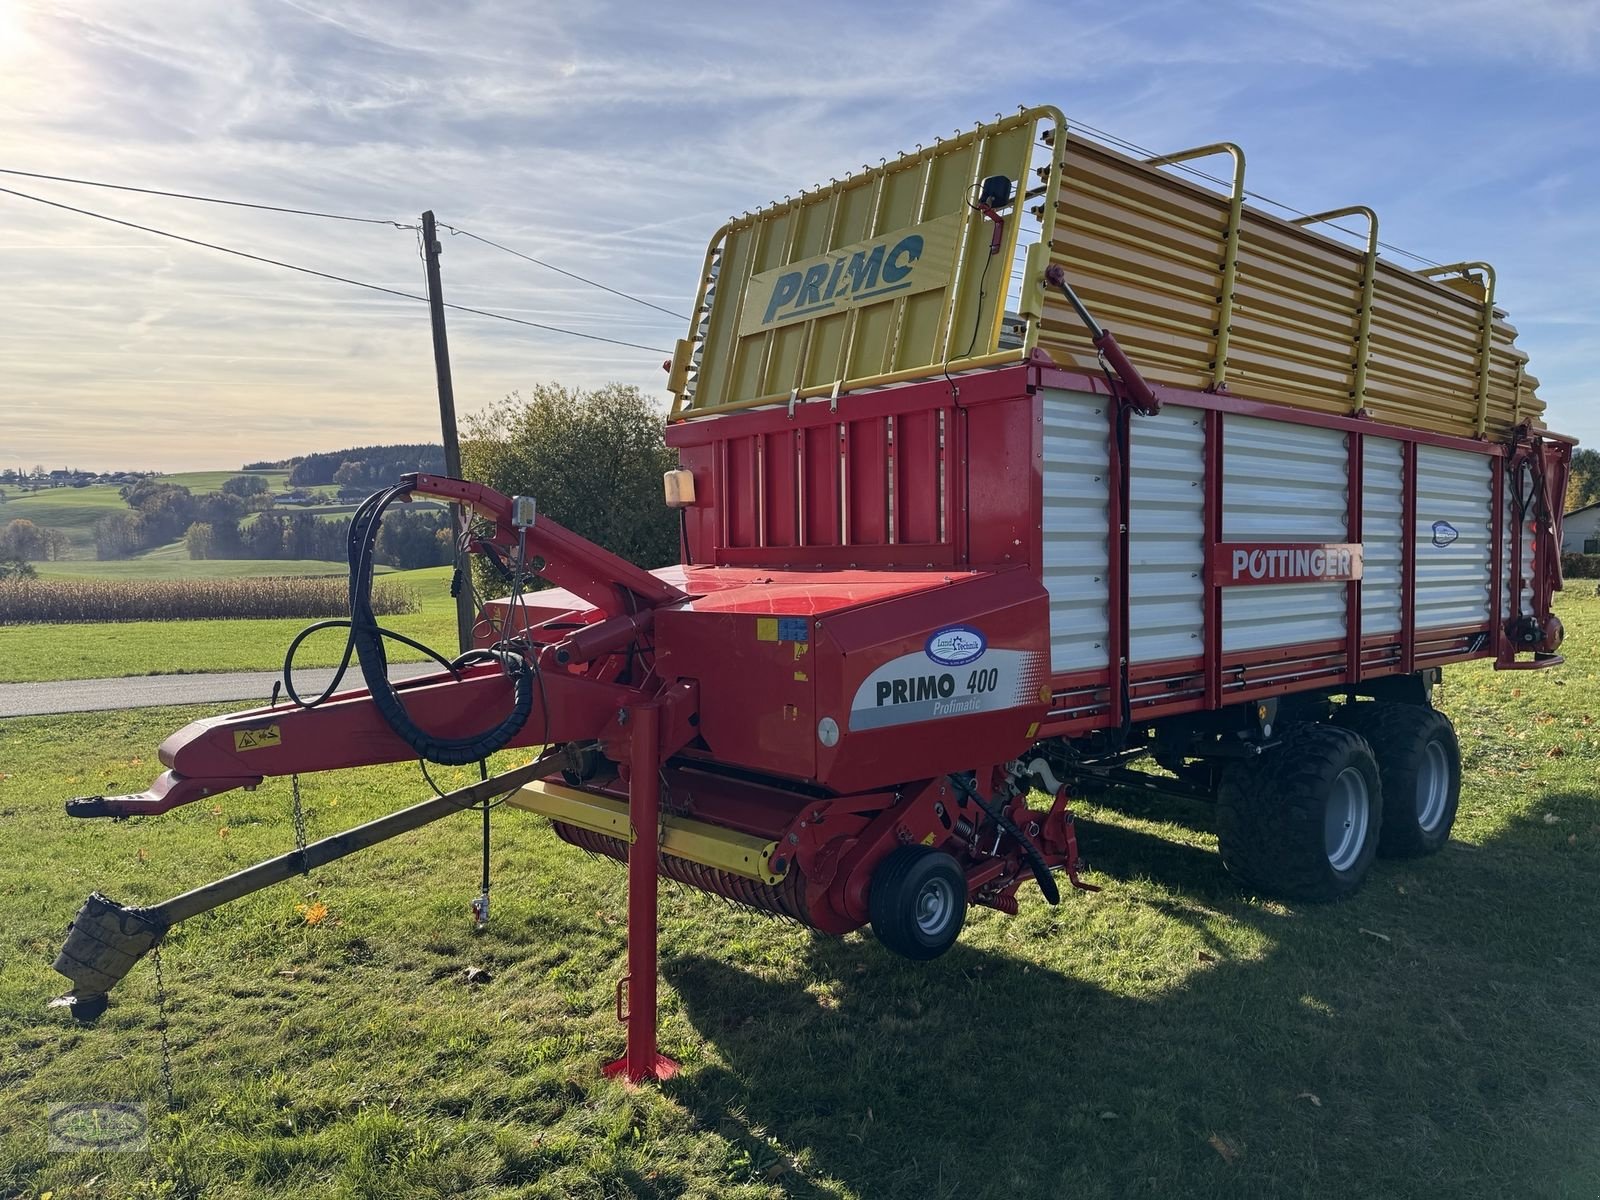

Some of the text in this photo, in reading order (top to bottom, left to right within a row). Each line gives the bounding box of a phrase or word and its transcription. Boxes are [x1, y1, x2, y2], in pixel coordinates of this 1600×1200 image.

[762, 234, 924, 325] PRIMO
[937, 638, 952, 647] Land
[876, 667, 999, 706] PRIMO 400
[933, 697, 981, 716] Profimatic
